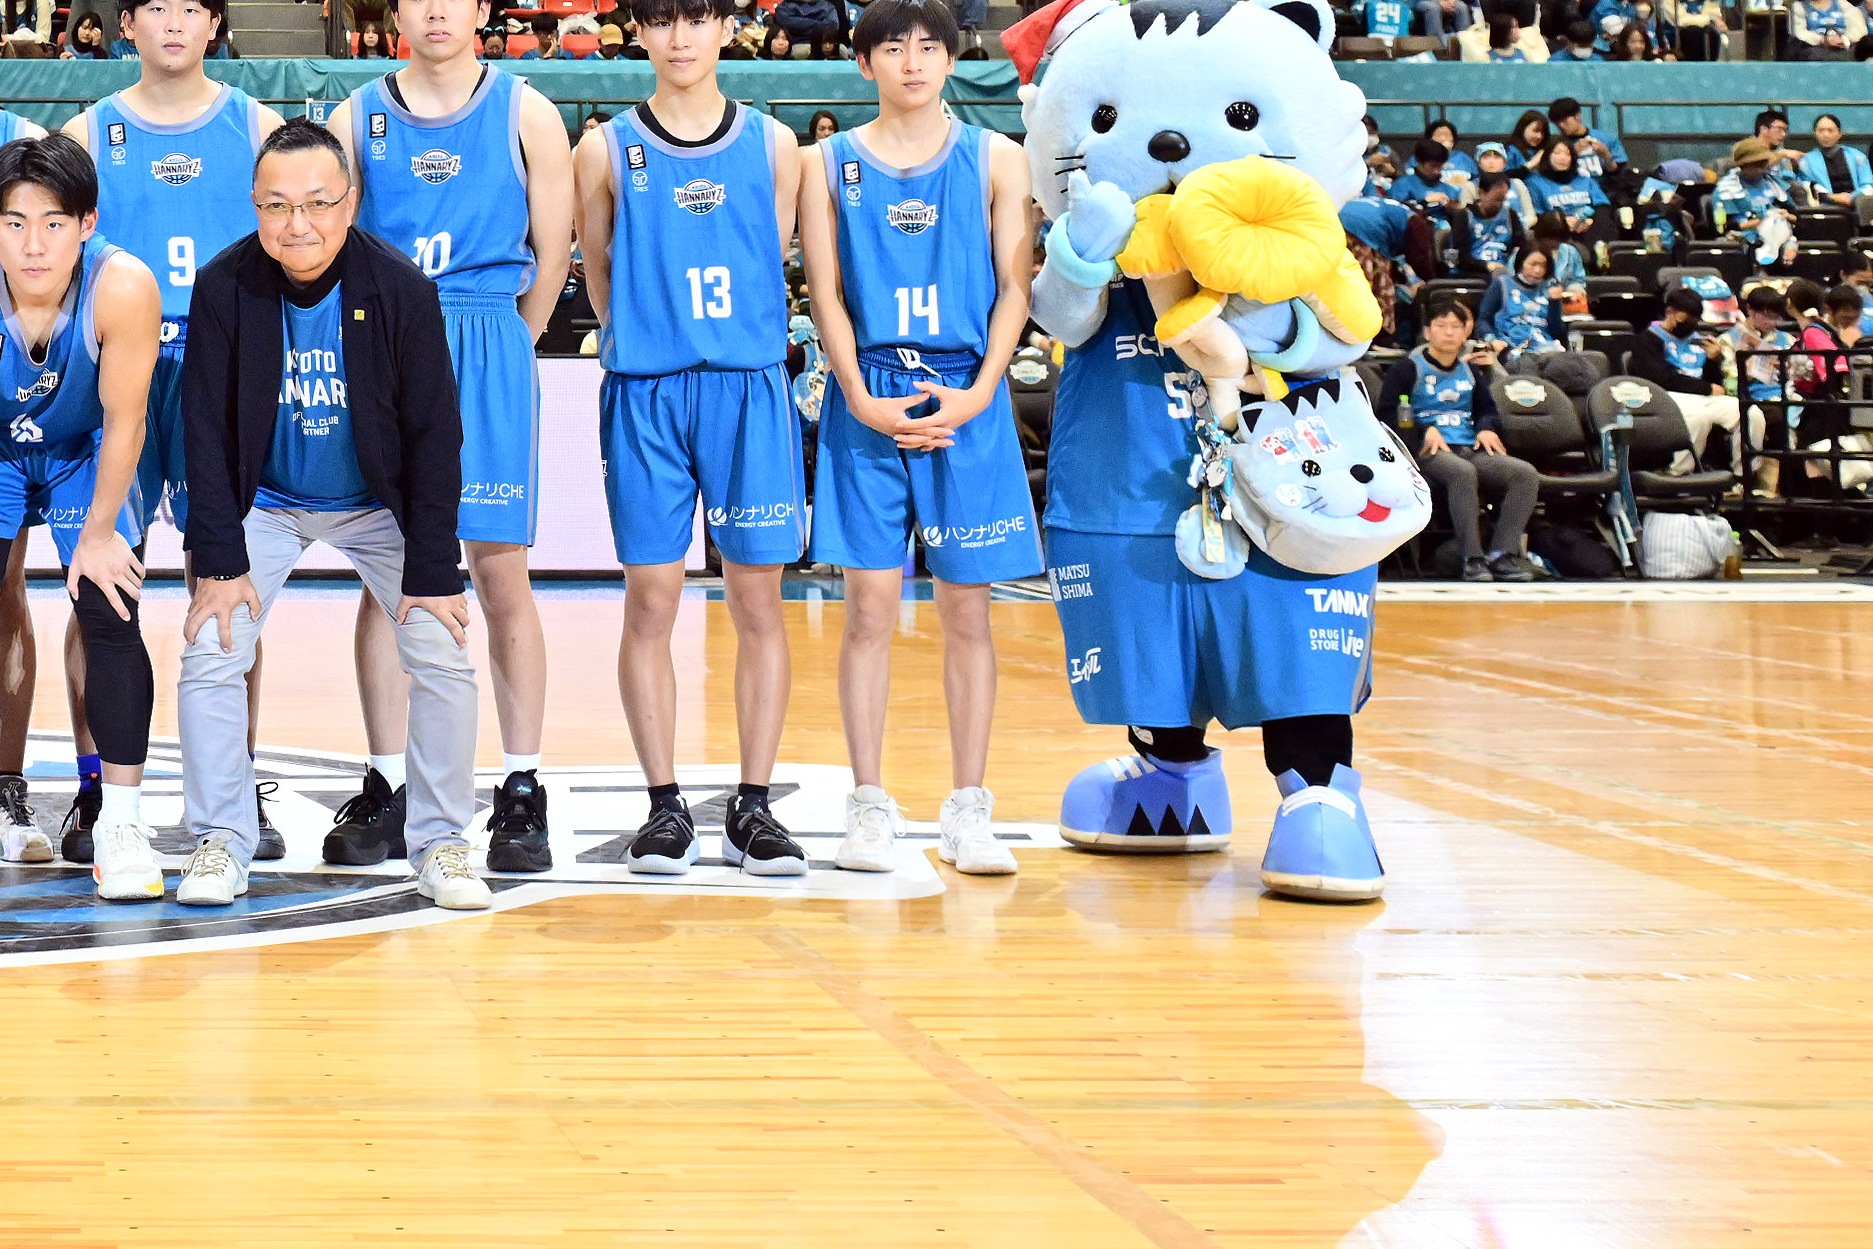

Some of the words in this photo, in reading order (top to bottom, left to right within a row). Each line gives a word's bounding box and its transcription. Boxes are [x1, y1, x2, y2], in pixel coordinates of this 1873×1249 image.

[1375, 3, 1402, 24] 24
[312, 107, 325, 121] 13
[150, 159, 203, 175] HANNARYZ
[411, 158, 462, 175] HANNARYZ
[674, 188, 726, 206] HANNARYZ
[886, 207, 938, 223] HANNARYZ
[168, 236, 196, 287] 9
[410, 231, 452, 275] 10
[685, 265, 733, 320] 13
[894, 283, 941, 337] 14
[319, 414, 339, 426] CLUB
[480, 498, 509, 506] CREATIVE
[54, 521, 74, 529] ENERGY
[735, 520, 756, 528] ENERGY
[757, 519, 786, 527] CREATIVE
[944, 515, 1026, 541] ハンナリCHE
[960, 540, 984, 548] ENERGY
[985, 536, 1006, 546] CREATIVE
[1058, 563, 1091, 581] MATSU
[1061, 582, 1094, 600] SHIMA
[1309, 628, 1339, 640] DRUG
